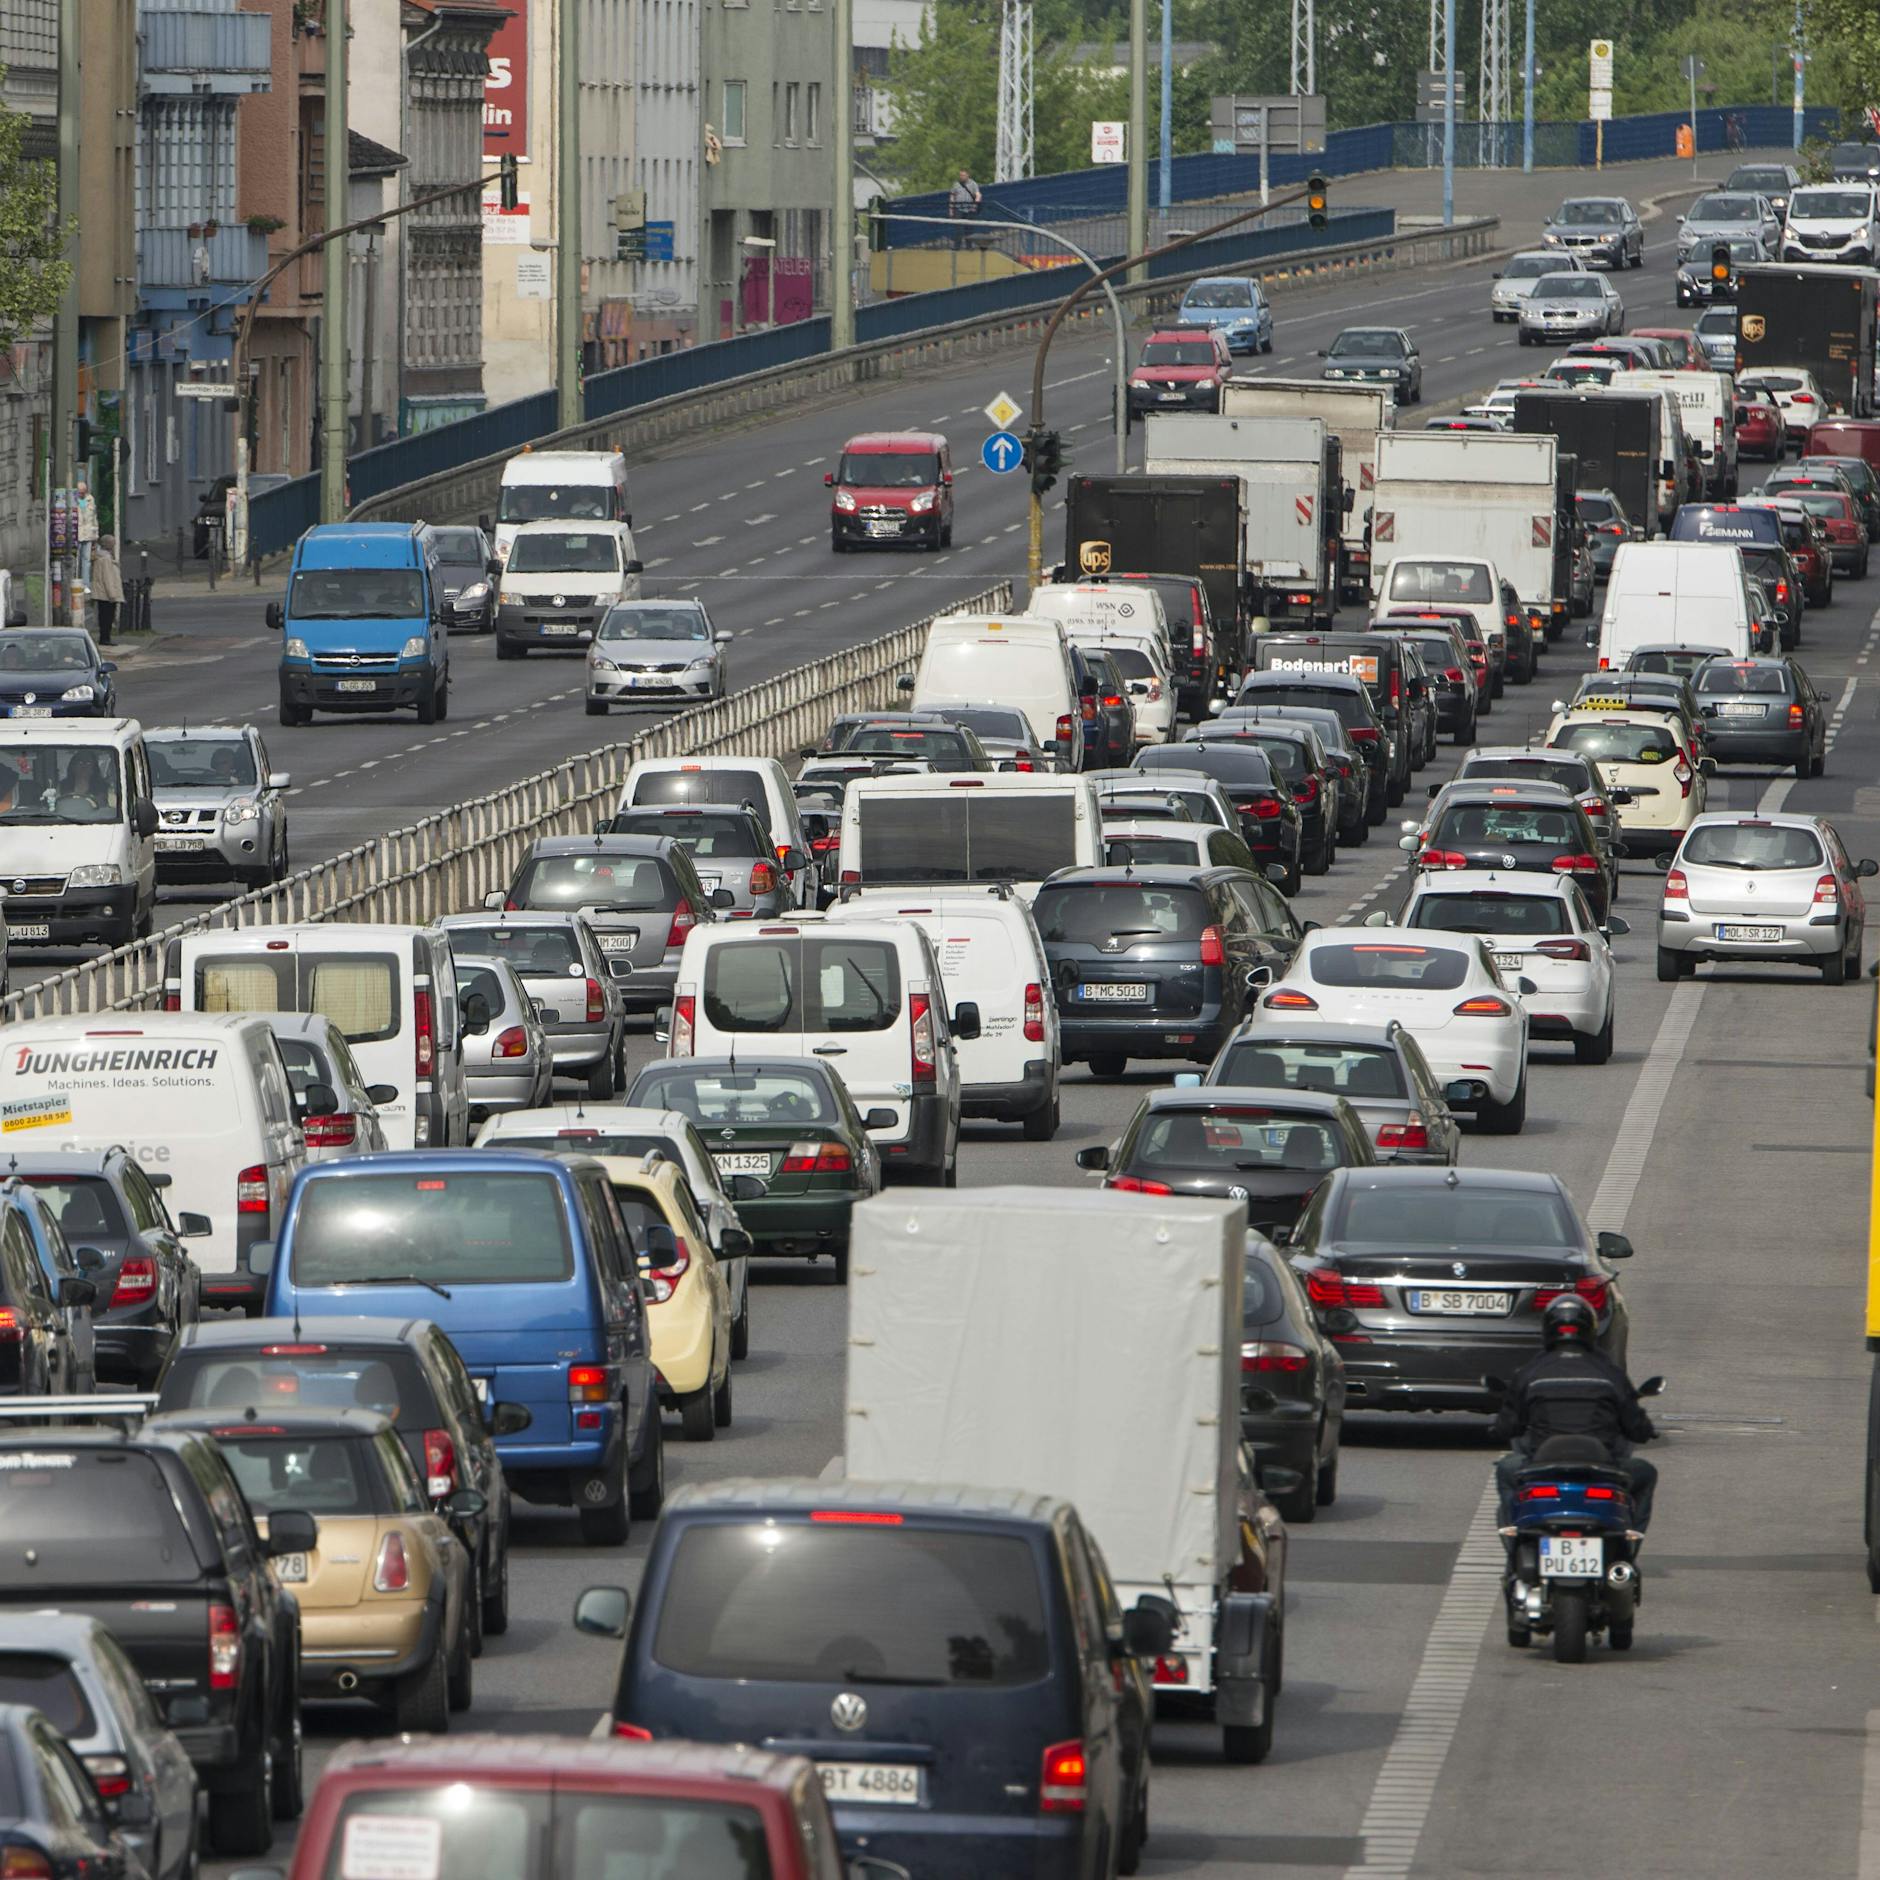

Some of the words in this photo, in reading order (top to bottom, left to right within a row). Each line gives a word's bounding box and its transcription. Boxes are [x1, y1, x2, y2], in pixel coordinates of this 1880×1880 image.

[1096, 601, 1116, 610] WSN
[29, 926, 48, 936] 813
[1724, 927, 1742, 938] MOL
[1748, 927, 1760, 938] SR
[1762, 928, 1780, 939] 127
[611, 937, 630, 948] 200
[1495, 955, 1520, 967] 1324
[1100, 985, 1114, 997] MC
[1116, 985, 1145, 997] 5018
[16, 1048, 218, 1076] JUNGHEINRICH
[48, 1079, 110, 1091] Machines.
[113, 1076, 149, 1088] Ideas.
[152, 1075, 215, 1088] Solutions.
[2, 1098, 67, 1116] Mietstapler
[735, 1155, 769, 1169] 1325
[1421, 1293, 1431, 1308] B
[1442, 1293, 1462, 1309] SB
[1466, 1294, 1505, 1310] 7004
[1561, 1540, 1572, 1556] B
[1544, 1558, 1565, 1573] PU
[1569, 1558, 1599, 1574] 612
[858, 1769, 914, 1793] 4886
